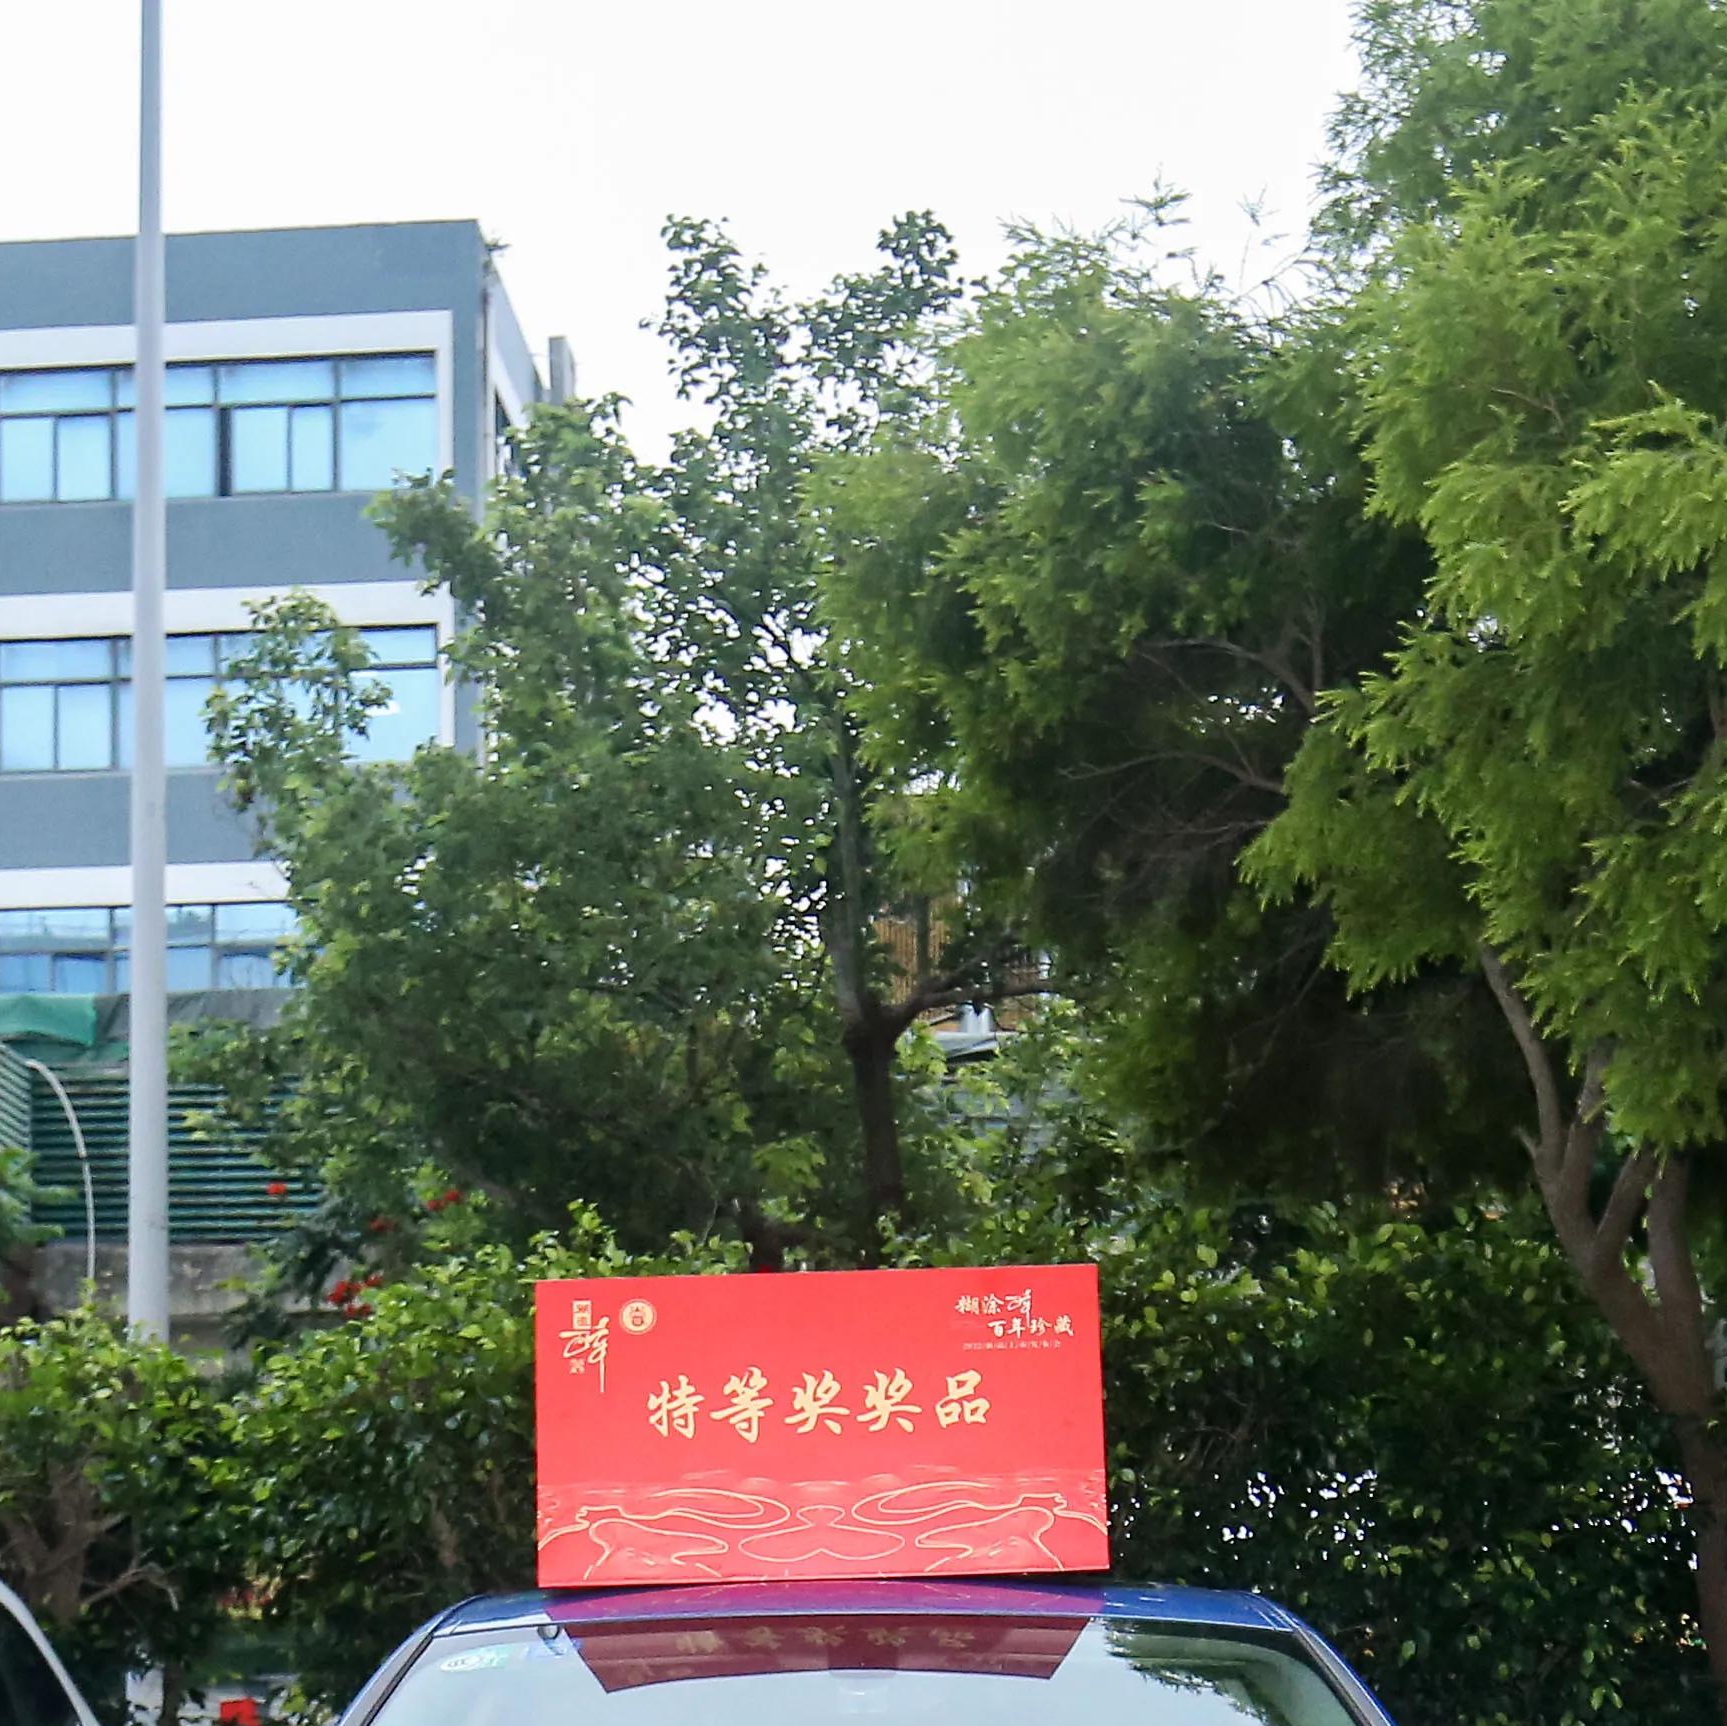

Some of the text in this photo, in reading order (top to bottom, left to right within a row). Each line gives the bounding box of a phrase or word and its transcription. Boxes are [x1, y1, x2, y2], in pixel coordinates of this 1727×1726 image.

[647, 1366, 990, 1443] 特等奖奖品
